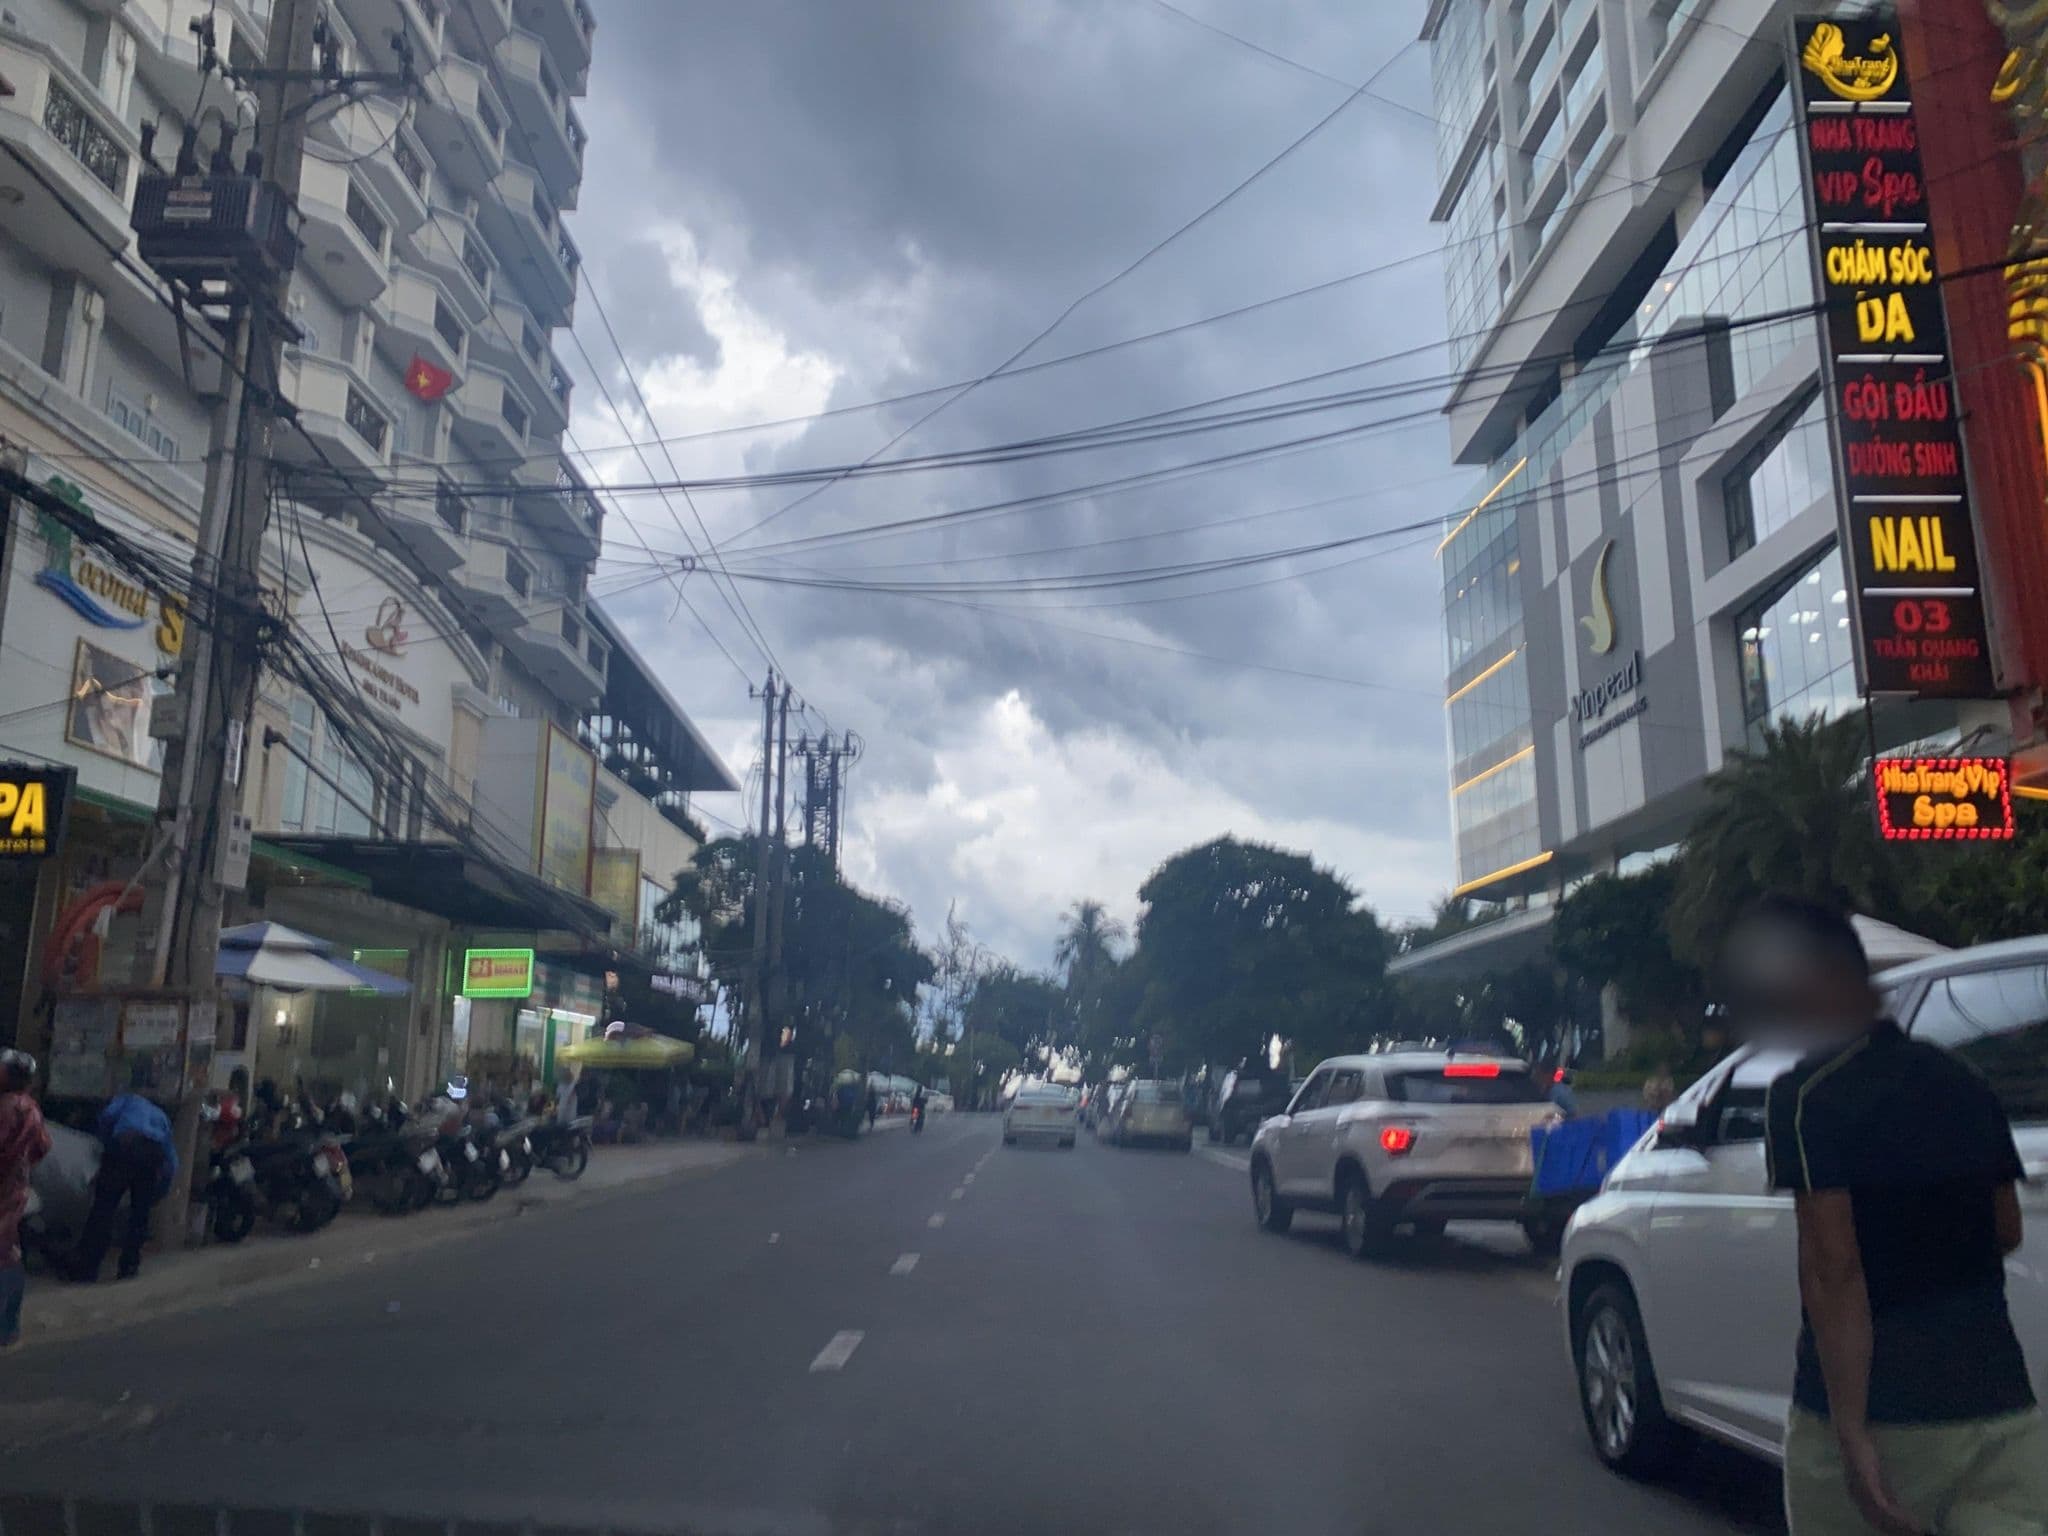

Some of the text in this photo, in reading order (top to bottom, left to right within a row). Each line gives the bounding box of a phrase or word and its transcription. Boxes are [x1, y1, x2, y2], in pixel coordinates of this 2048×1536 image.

[1810, 118, 1916, 151] NHA TRANG
[1816, 171, 1858, 204] VIP
[1826, 239, 1933, 285] CHĂM SÓC
[1914, 441, 1959, 477] SINH
[1869, 516, 1956, 573] NAIL
[72, 545, 148, 619] oconut
[1893, 599, 1952, 633] 03
[1912, 795, 1978, 829] Spa
